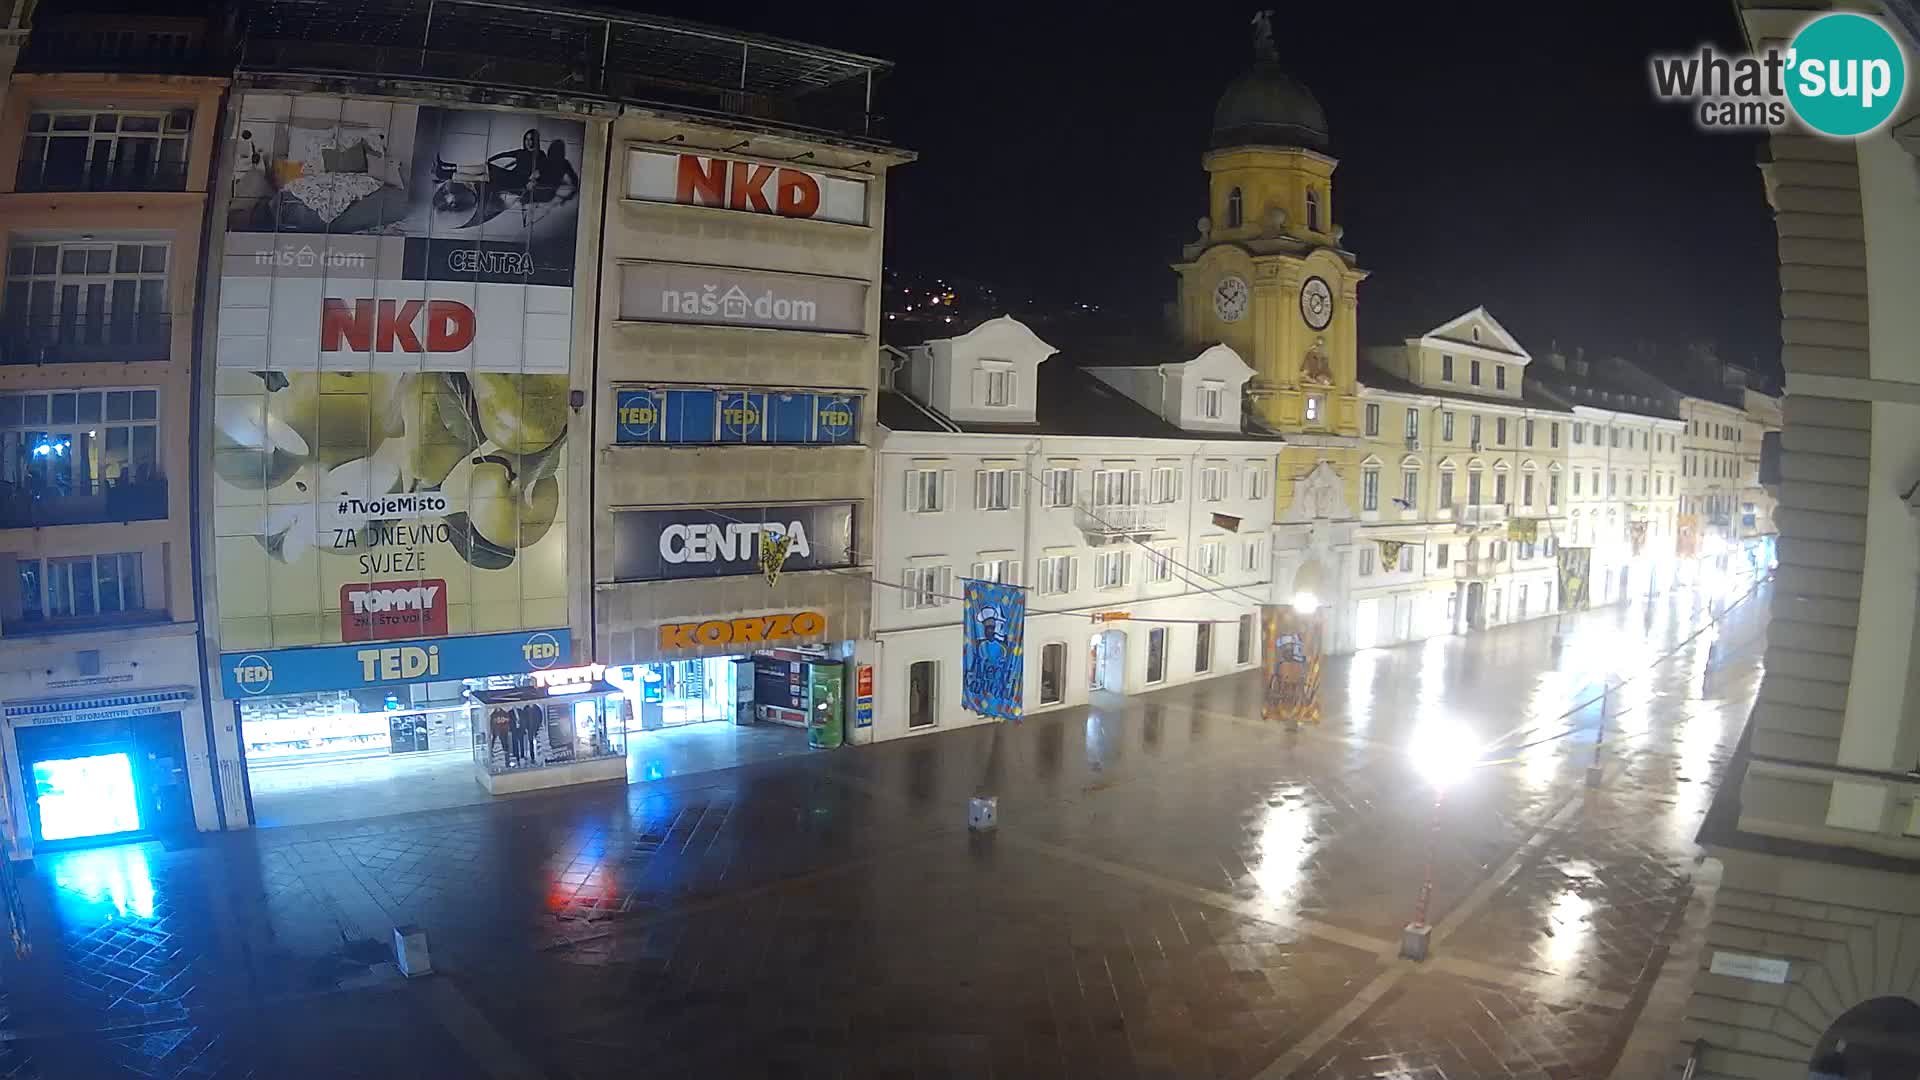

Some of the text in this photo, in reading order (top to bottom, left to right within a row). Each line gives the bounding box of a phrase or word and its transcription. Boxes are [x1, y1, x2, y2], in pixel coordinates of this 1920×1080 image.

[676, 153, 820, 219] NKD
[319, 247, 365, 269] dom
[448, 248, 535, 275] CENTRA
[661, 284, 817, 322] naš dom
[320, 297, 477, 353] NKD
[619, 407, 657, 425] TEDi
[338, 496, 446, 516] #TvojeMisto
[333, 523, 450, 549] ZA DNEVNO
[360, 547, 426, 575] SVJEŽE
[348, 586, 439, 614] TOMMY
[659, 611, 825, 649] KORZO
[357, 645, 440, 682] TEDi
[522, 640, 560, 661] TEDi
[234, 665, 273, 684] TEDi
